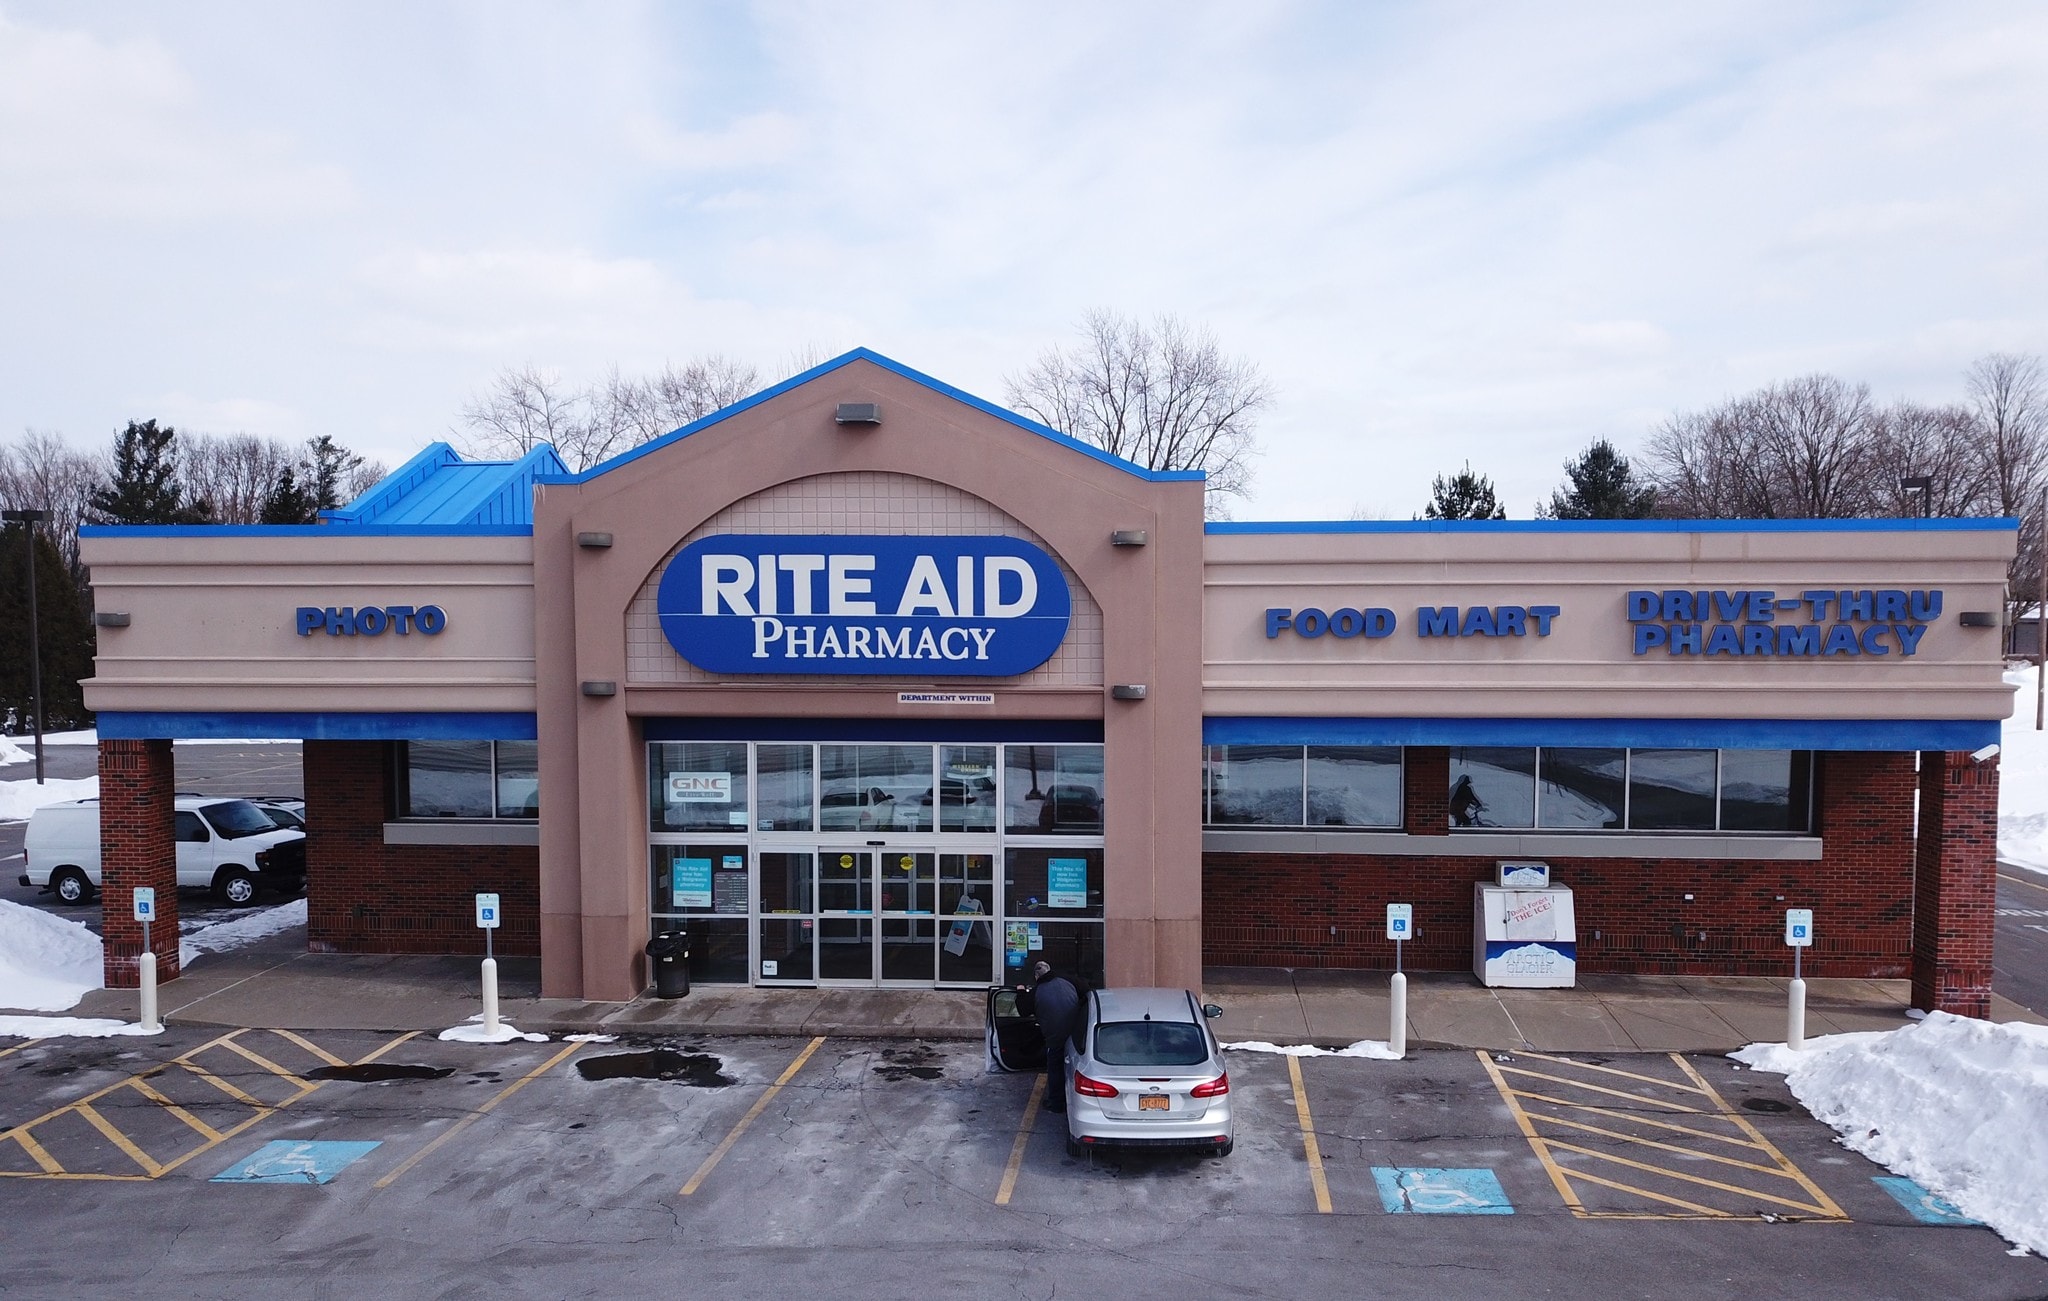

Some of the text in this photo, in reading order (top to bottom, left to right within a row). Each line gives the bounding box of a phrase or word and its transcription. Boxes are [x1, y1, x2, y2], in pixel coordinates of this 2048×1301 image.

[701, 554, 1038, 618] RITE AID
[296, 605, 448, 636] PHOTO
[1626, 590, 1943, 622] DRIVE-THRU
[1266, 606, 1561, 639] FOOD MART
[752, 617, 996, 660] PHARMACY
[1633, 624, 1928, 656] PHARMACY
[672, 778, 728, 790] GNC
[1514, 902, 1552, 922] THE ICE!
[1506, 951, 1555, 965] ARCTIC
[1507, 963, 1555, 974] GLACIER
